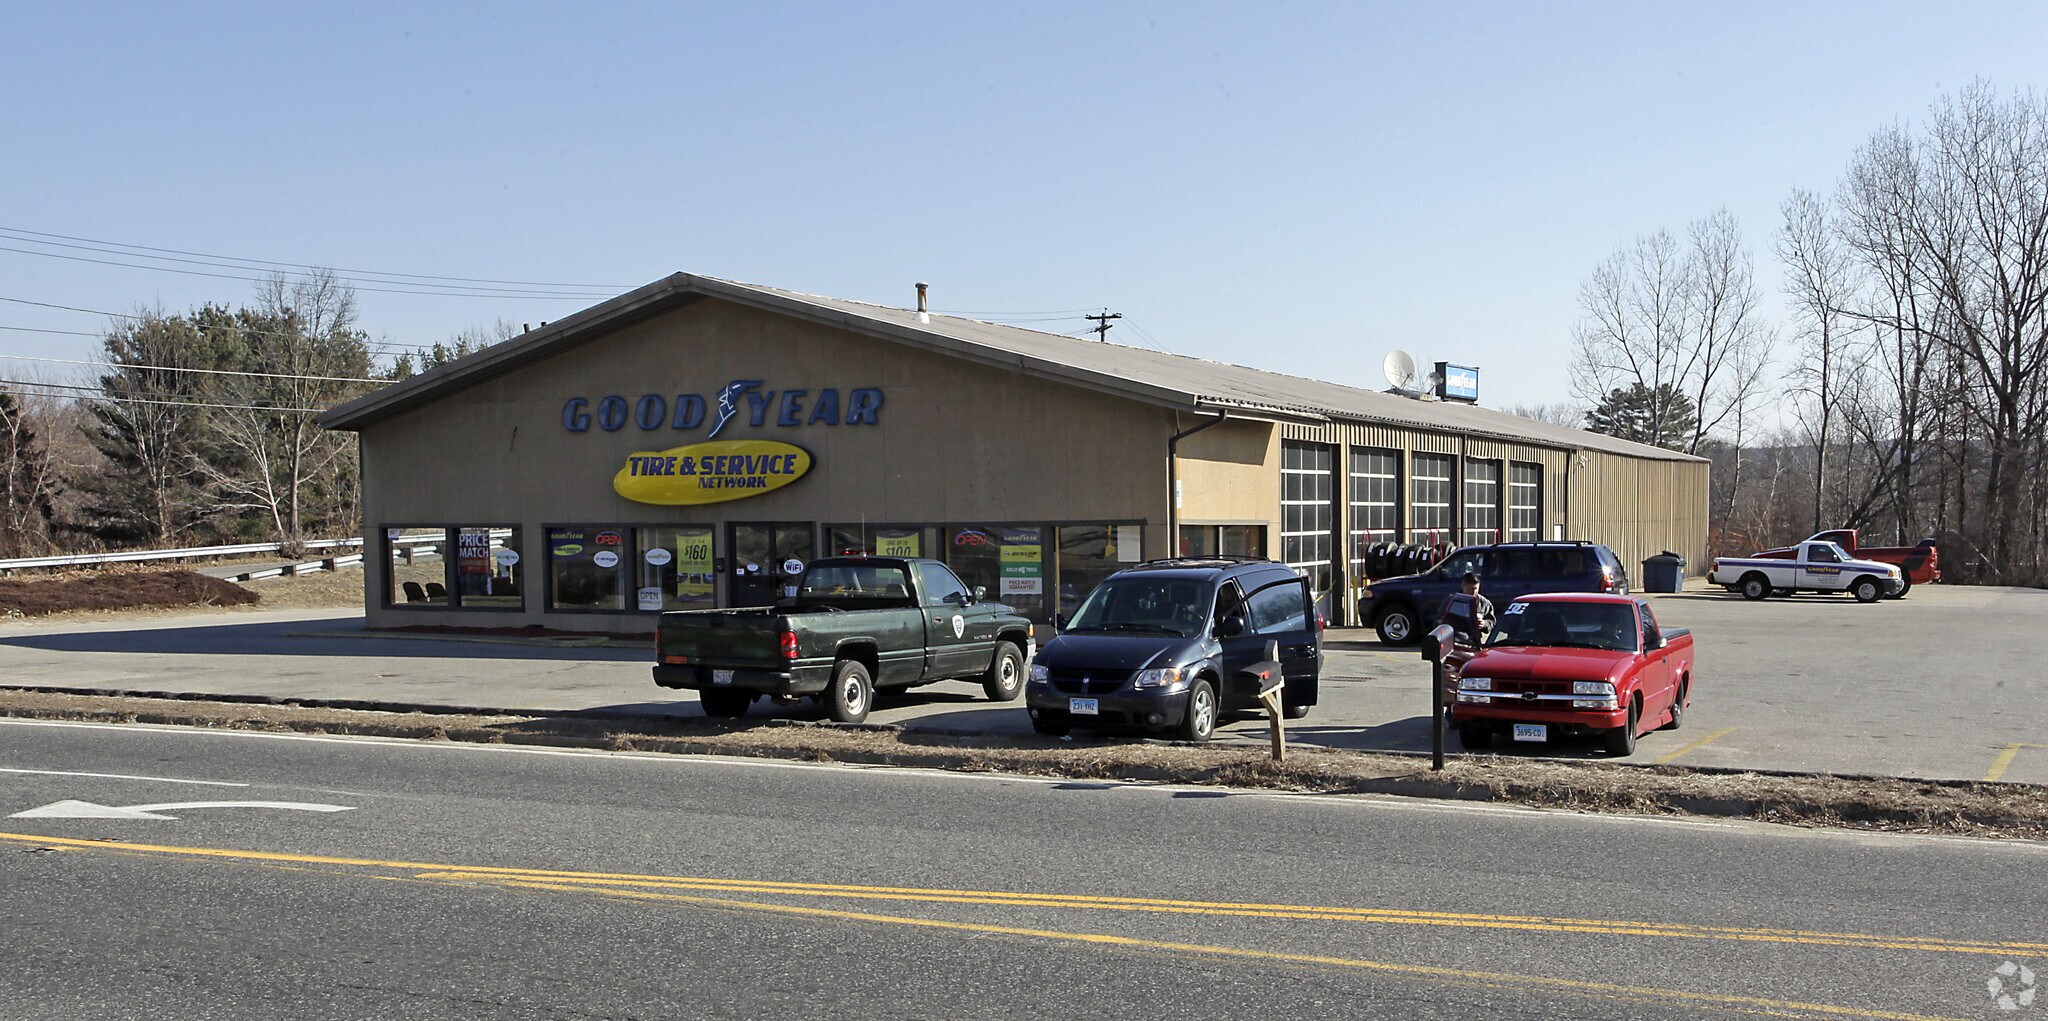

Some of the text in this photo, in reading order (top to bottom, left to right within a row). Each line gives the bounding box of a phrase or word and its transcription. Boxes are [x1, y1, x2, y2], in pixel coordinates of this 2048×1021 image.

[629, 454, 797, 477] TIRE & SERVICE
[698, 476, 767, 489] NETWORK
[459, 533, 489, 547] PRICE
[595, 534, 622, 545] OPEN
[957, 534, 988, 546] OPEN
[459, 547, 489, 558] MATCH
[684, 544, 707, 560] $160
[640, 592, 659, 600] OPEN
